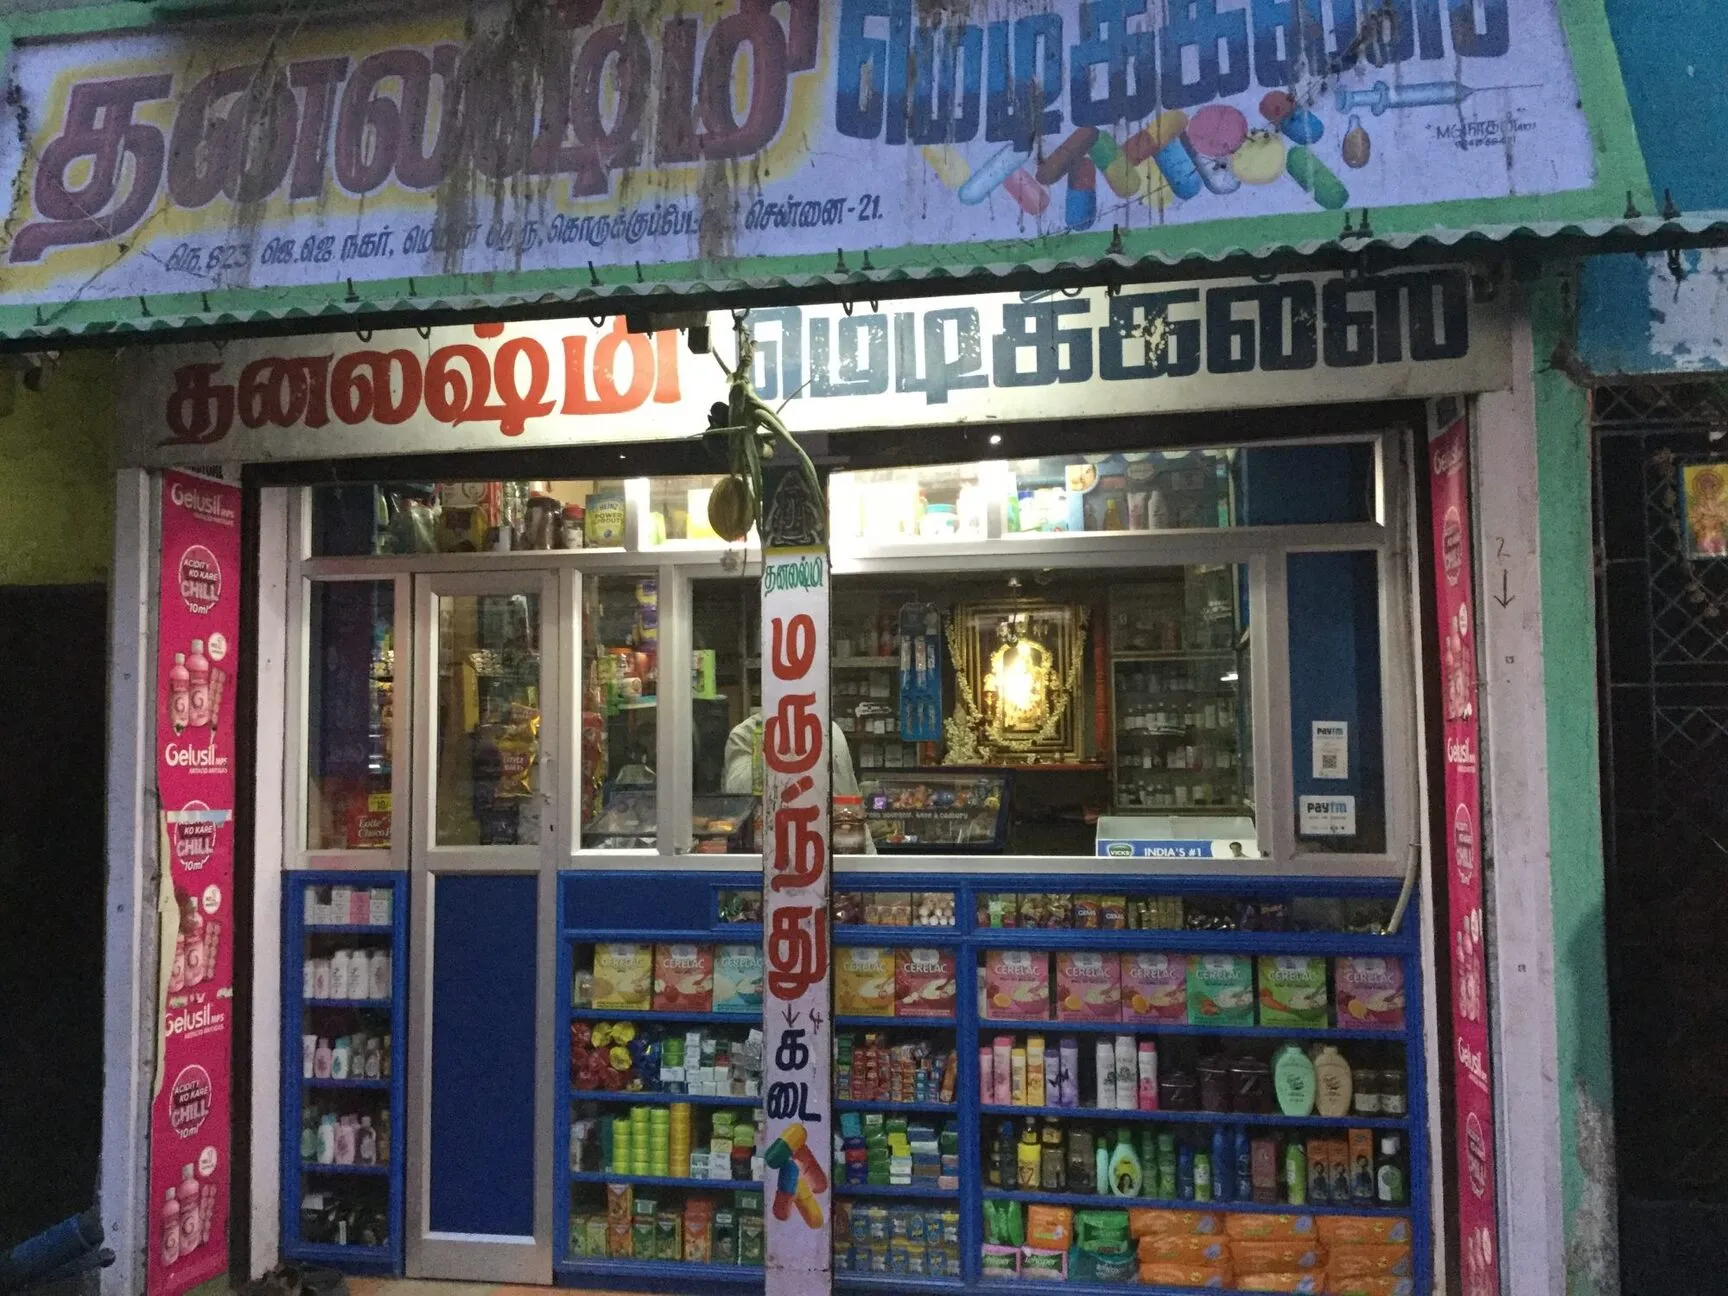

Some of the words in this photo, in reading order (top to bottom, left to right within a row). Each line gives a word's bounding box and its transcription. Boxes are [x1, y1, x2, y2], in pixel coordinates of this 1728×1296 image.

[158, 315, 682, 445] தனலஷ்மி
[171, 483, 220, 515] Gelusil
[183, 559, 210, 569] ACIDITY
[189, 569, 199, 578] KO
[200, 571, 218, 581] KARE
[181, 580, 219, 601] CHILL
[166, 743, 214, 766] Gelusil
[184, 826, 195, 835] KO
[195, 825, 212, 834] KARE
[176, 838, 213, 858] CHILL
[1110, 849, 1131, 857] VICKS
[1144, 847, 1186, 857] INDIA'S
[1188, 847, 1202, 857] #1
[664, 958, 704, 969] CERELAC
[843, 963, 886, 973] CERELAC
[903, 963, 948, 974] CERELAC
[995, 964, 1040, 976] CERELAC
[1065, 967, 1111, 978] CERELAC
[1130, 968, 1178, 980] CERELAC
[1196, 968, 1241, 980] CERELAC
[1268, 970, 1316, 982] CERELAC
[1346, 971, 1394, 984] CERELAC
[166, 1003, 211, 1037] Gelusil
[174, 1081, 200, 1095] ACIDITY
[190, 1086, 210, 1100] KARE
[171, 1103, 209, 1127] CHILL
